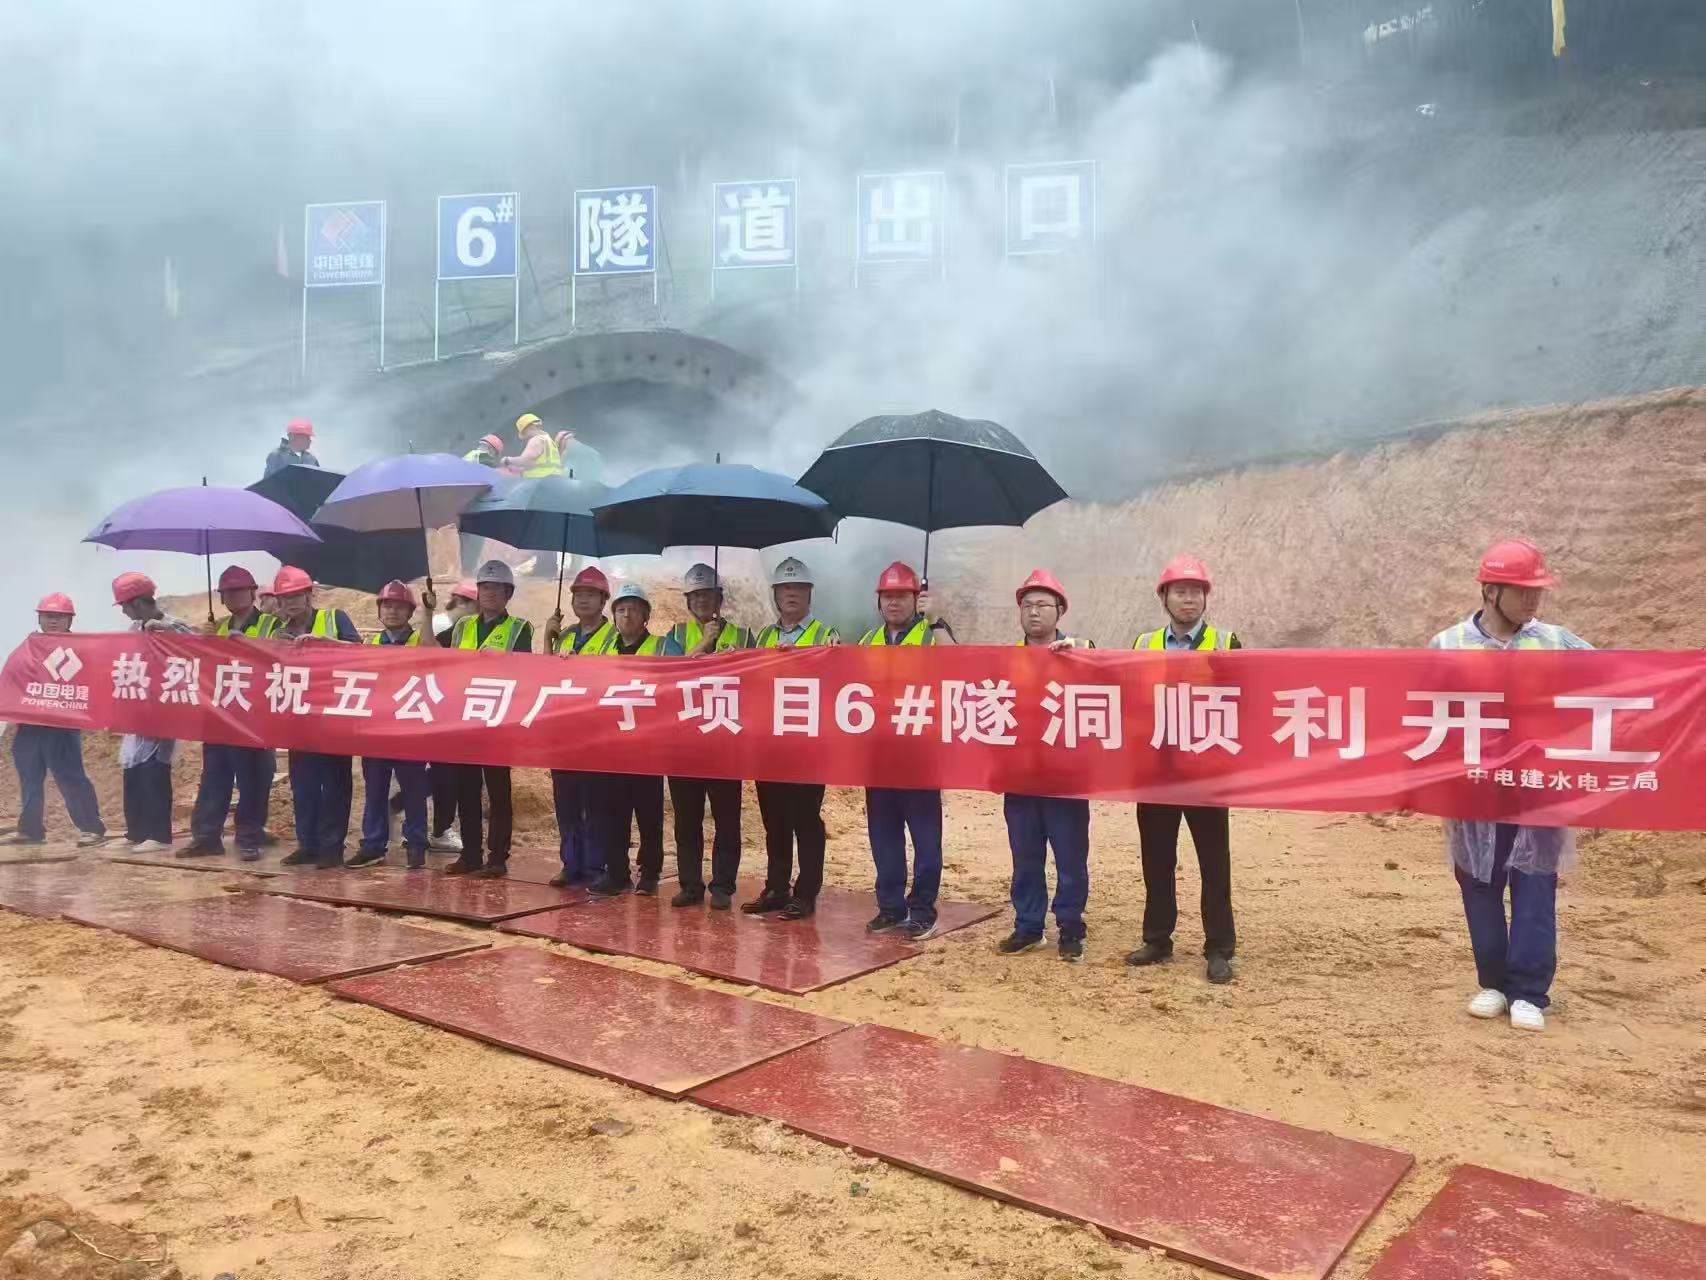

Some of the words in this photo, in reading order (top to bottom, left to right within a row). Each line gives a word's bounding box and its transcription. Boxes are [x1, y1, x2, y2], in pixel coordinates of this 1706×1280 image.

[21, 697, 89, 711] POWERCHINA
[111, 652, 1660, 765] 热烈庆祝五公司广宁项目6#隧洞顺利开工
[1467, 767, 1659, 793] 中电建水电三局
